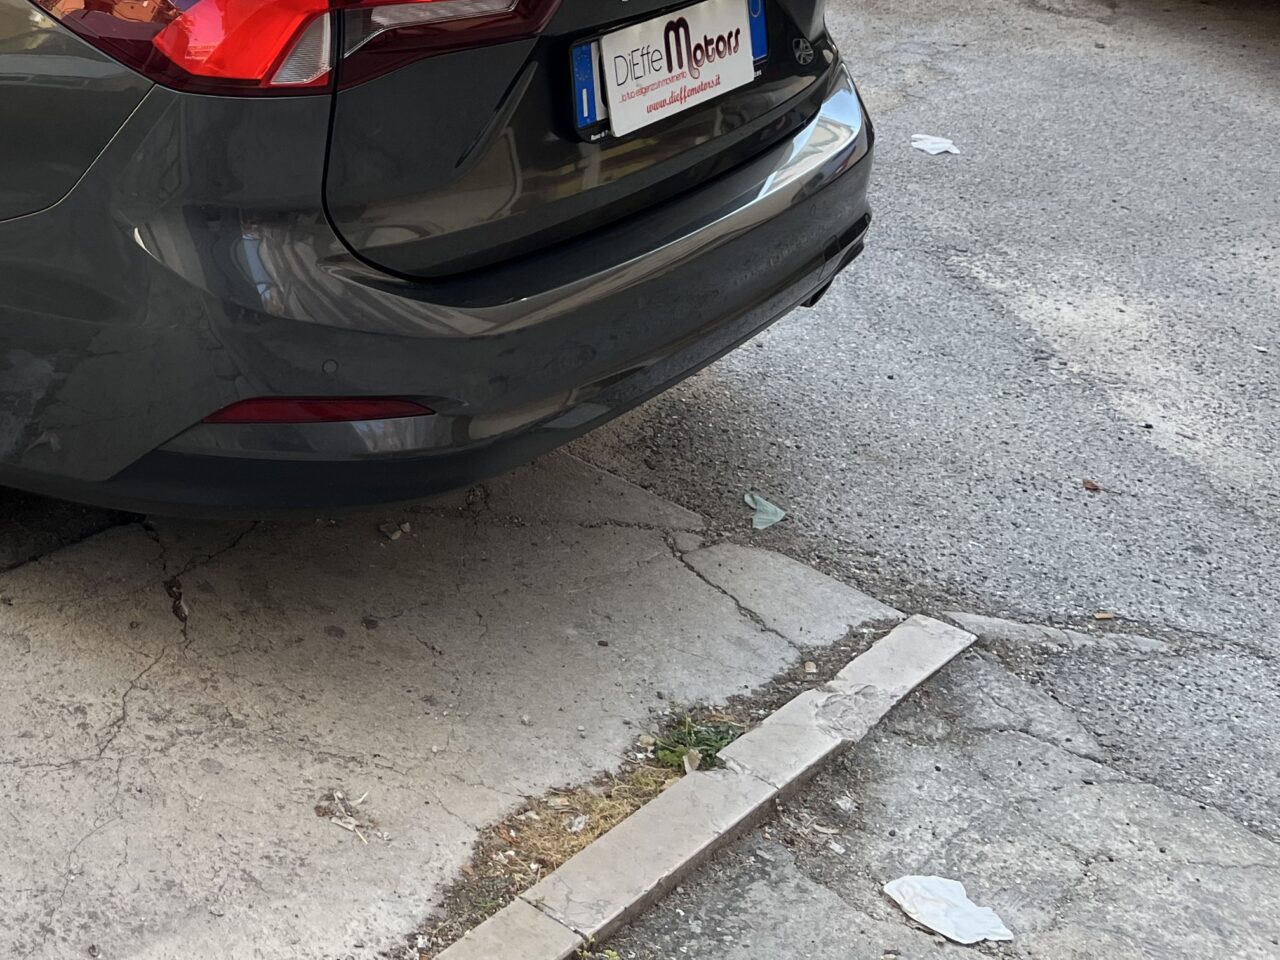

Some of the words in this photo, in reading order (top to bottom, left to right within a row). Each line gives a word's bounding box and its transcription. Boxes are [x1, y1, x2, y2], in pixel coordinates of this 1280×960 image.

[614, 44, 663, 86] DiEffe
[664, 16, 741, 80] Motors
[646, 73, 721, 114] www.dieffemotors.it
